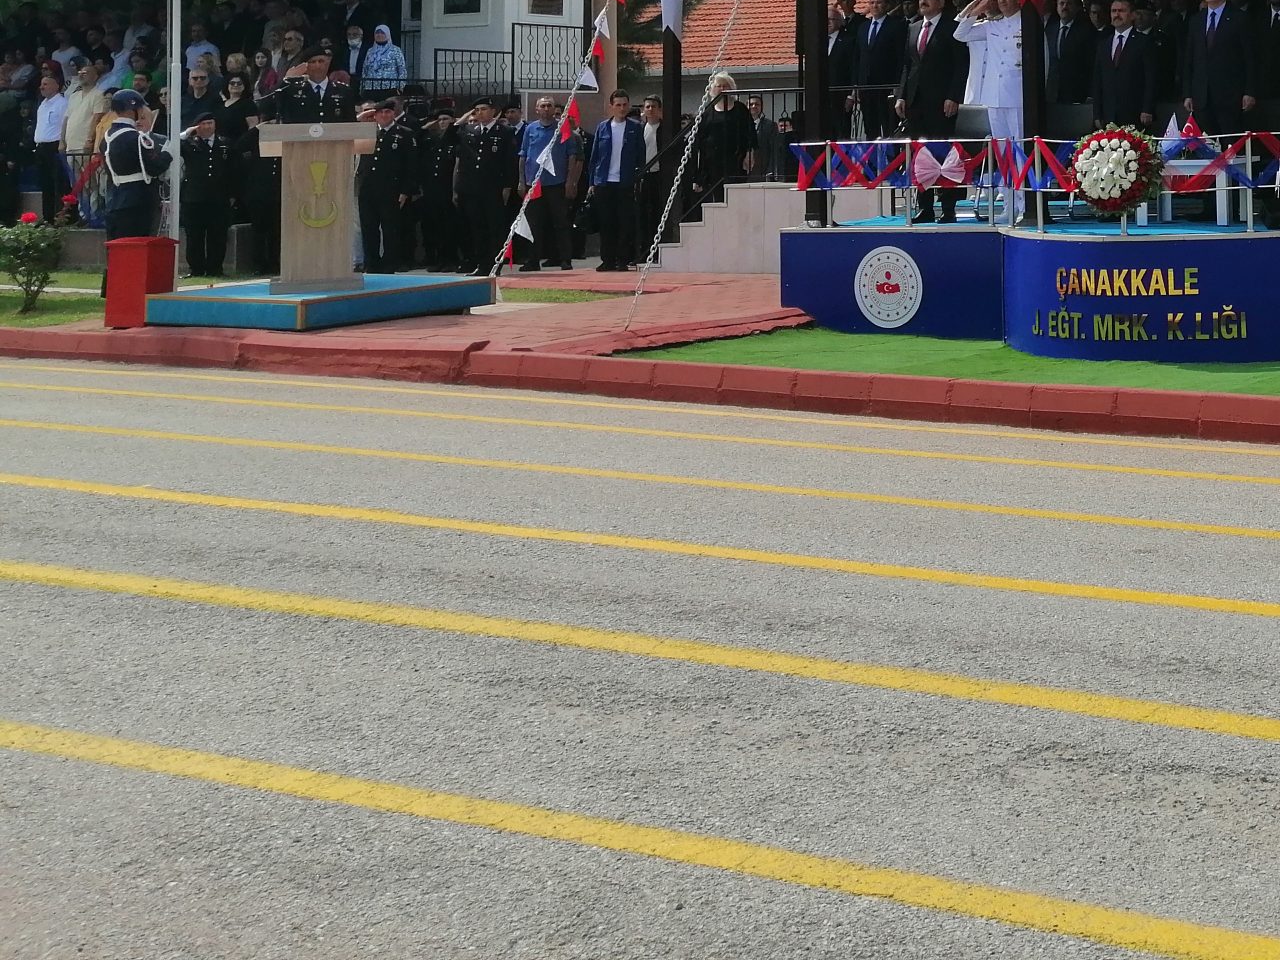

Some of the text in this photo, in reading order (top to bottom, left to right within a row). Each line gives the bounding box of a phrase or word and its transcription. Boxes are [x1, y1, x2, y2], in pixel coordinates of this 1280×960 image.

[1056, 267, 1199, 300] ÇANAKKALE
[1048, 305, 1086, 339] EĞT.
[1093, 312, 1158, 341] MRK.
